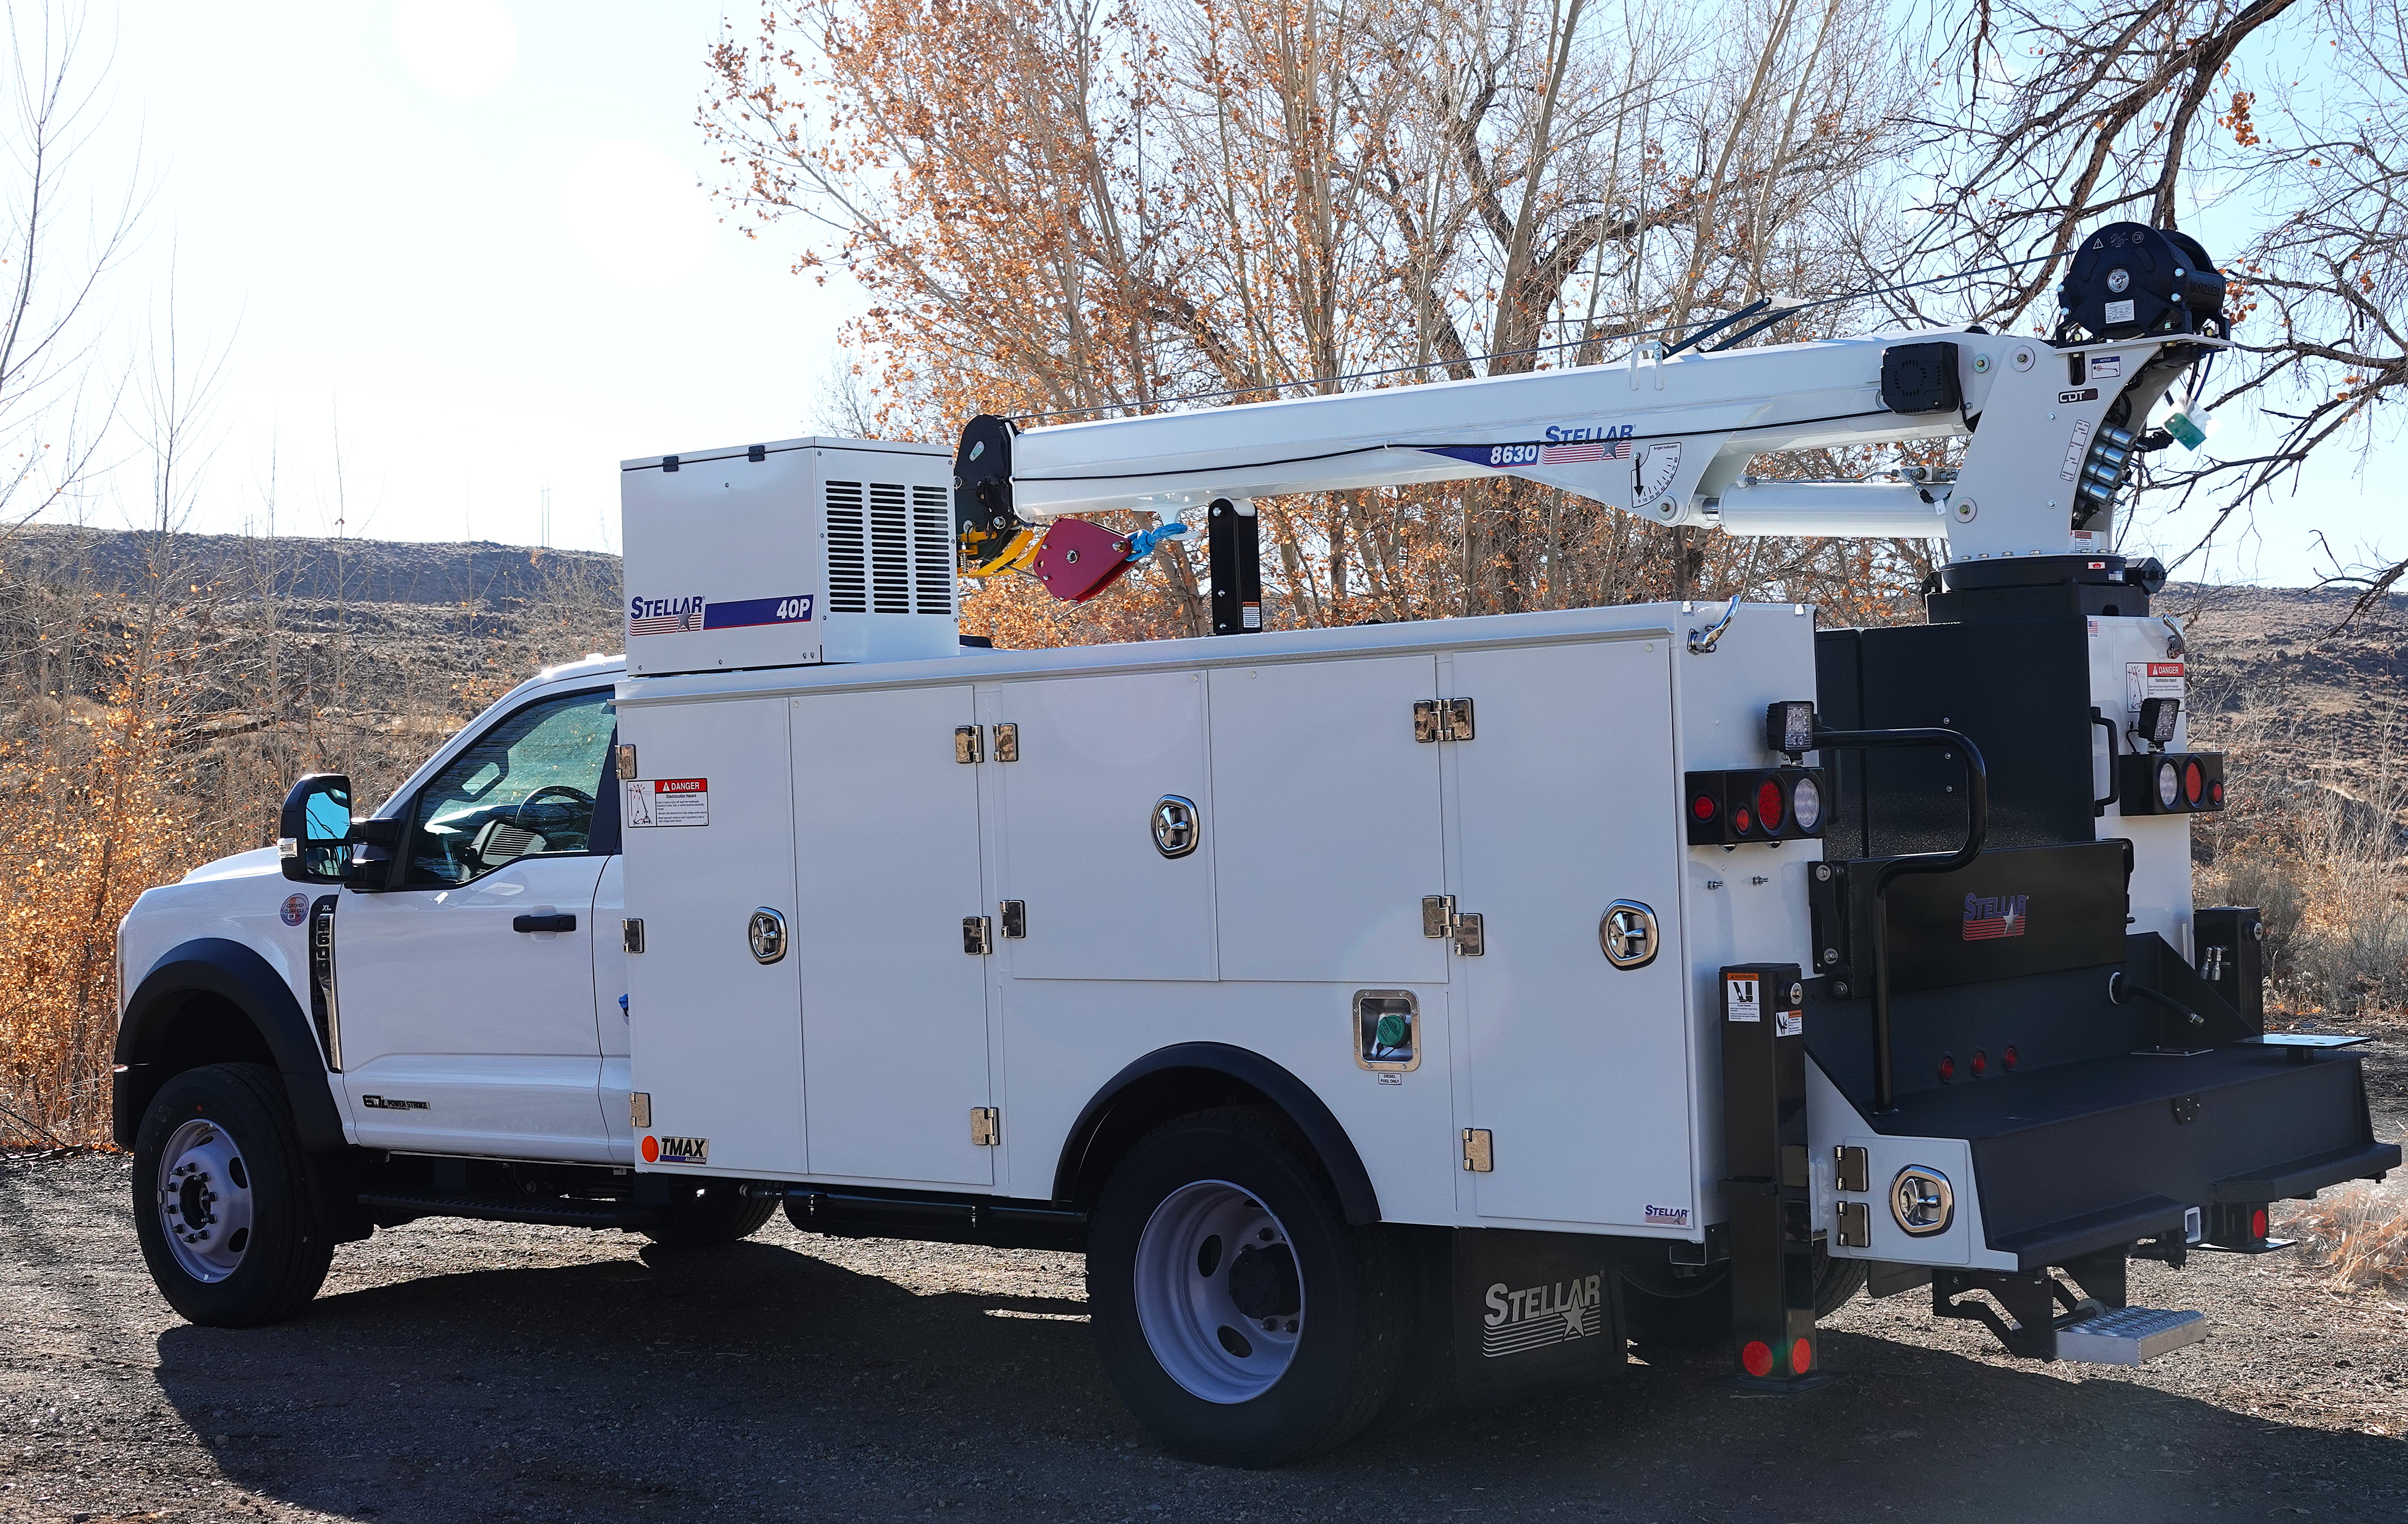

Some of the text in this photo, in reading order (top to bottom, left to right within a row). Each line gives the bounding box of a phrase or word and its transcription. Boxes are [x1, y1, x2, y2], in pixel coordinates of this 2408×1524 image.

[1544, 425, 1633, 448] STELLAR
[1490, 445, 1537, 465] 8630
[630, 596, 702, 619] STELLAR
[776, 598, 810, 620] 40P
[671, 782, 700, 790] DANGER
[1963, 893, 2026, 921] STELLAR
[662, 1138, 705, 1157] TMAX
[1645, 1205, 1687, 1217] STELLAR
[1484, 1275, 1600, 1326] STELLAR
